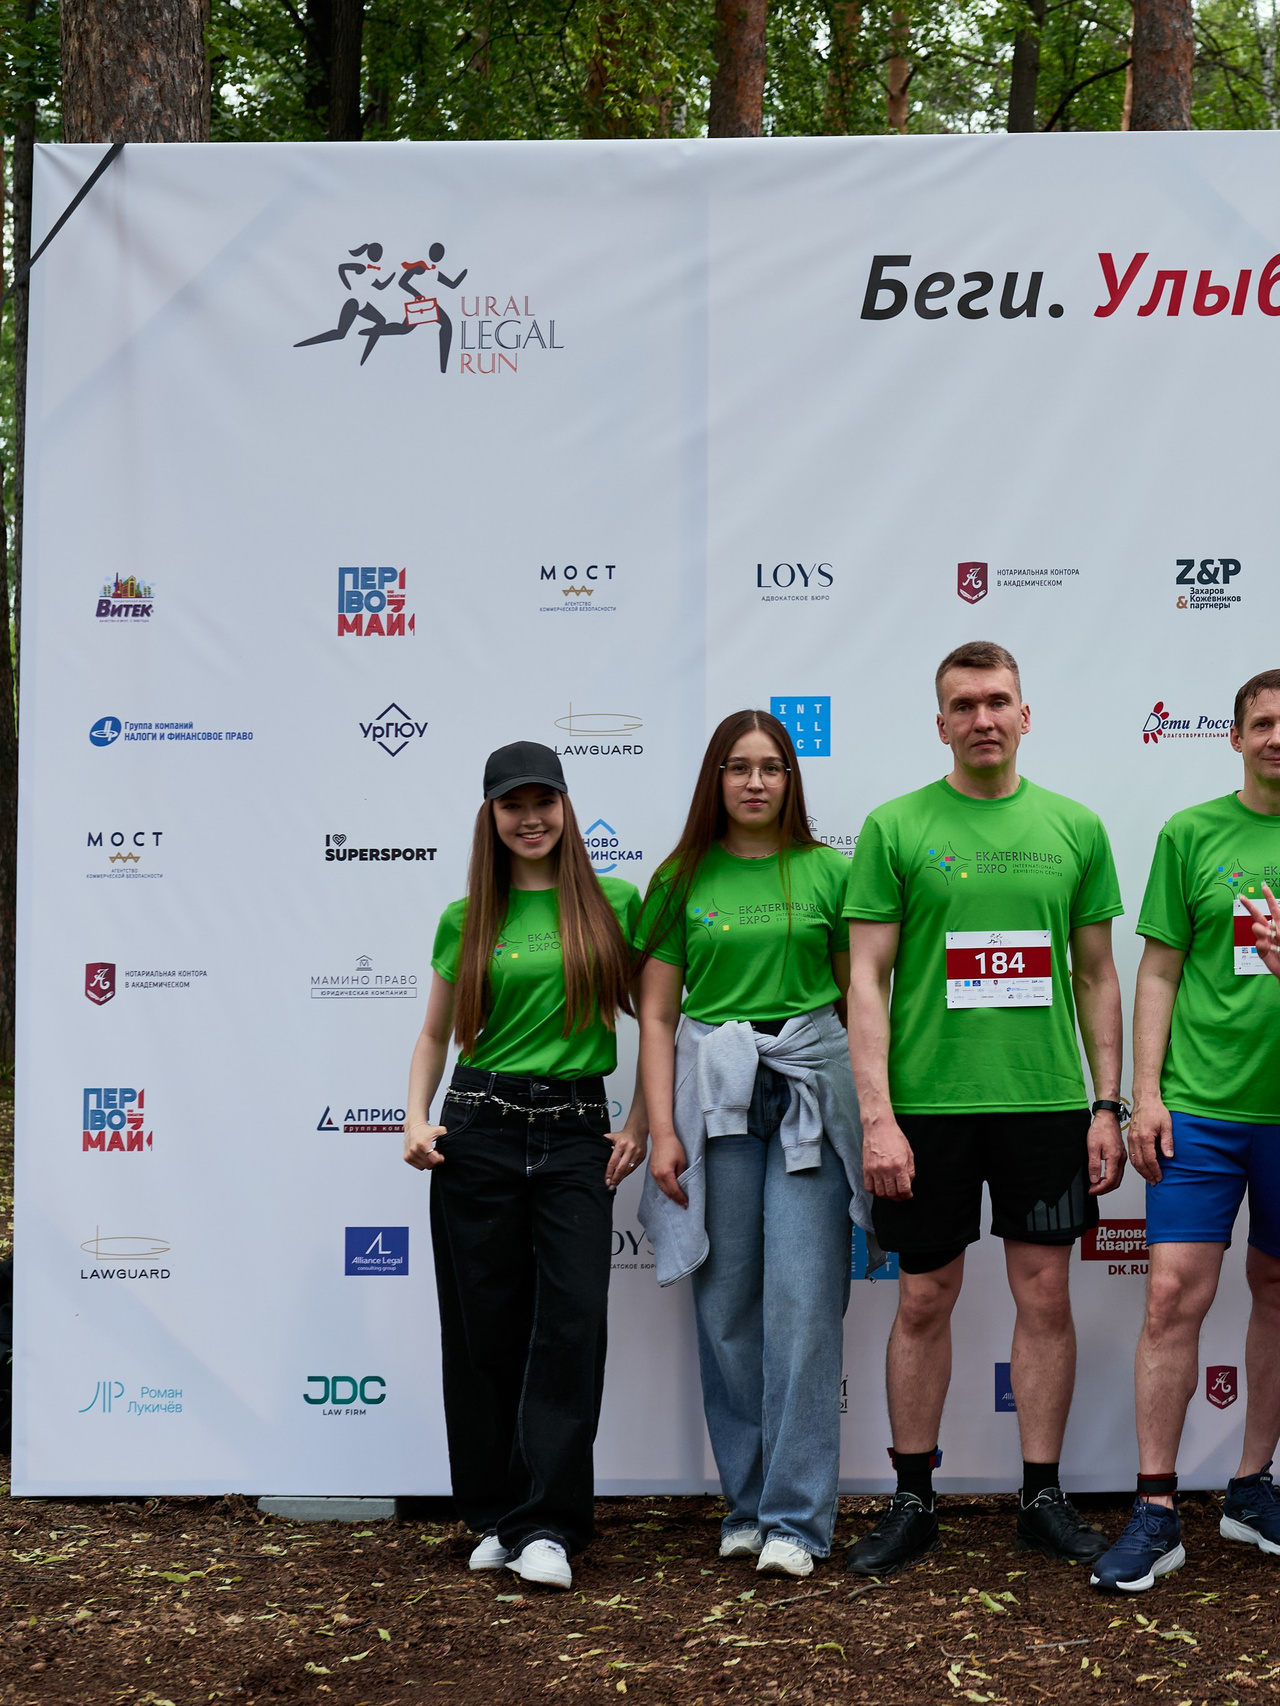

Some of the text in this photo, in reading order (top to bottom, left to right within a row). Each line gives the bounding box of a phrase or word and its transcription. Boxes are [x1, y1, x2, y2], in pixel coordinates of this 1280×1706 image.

[860, 255, 1064, 320] Беги.
[460, 296, 535, 317] URAL
[461, 320, 564, 349] LEGAL
[461, 353, 517, 374] RUN
[541, 565, 616, 580] МОСТ
[757, 563, 833, 587] LOYS
[1050, 568, 1080, 576] КОНТОРА
[1176, 558, 1242, 585] Z&P
[1003, 579, 1062, 587] АКАДЕМИЧЕСКОМ
[1190, 587, 1224, 595] Захаров
[1190, 593, 1241, 602] Кожевников
[1190, 602, 1231, 610] партнеры
[124, 720, 194, 732] Группа компаний
[124, 731, 254, 741] НАЛОГИ И ФИНАНСОВОЕ ПРАВО
[554, 744, 644, 756] LAWGUARD
[88, 832, 162, 846] МОСТ
[325, 848, 437, 861] SUPERSPORT
[976, 852, 1062, 864] EKATERINBURG
[977, 864, 1007, 874] EXPO
[739, 914, 770, 925] EXPO
[975, 951, 1026, 974] 184
[125, 970, 176, 978] НОТАРИАЛЬНАЯ
[311, 975, 417, 985] МАМИНО ПРАВО
[1096, 1240, 1149, 1253] кварта
[351, 1256, 403, 1266] Alliance Legal
[81, 1269, 170, 1279] LAWGUARD
[1108, 1264, 1149, 1275] DK.RU
[141, 1387, 183, 1400] Роман
[127, 1400, 183, 1416] Лукичёв
